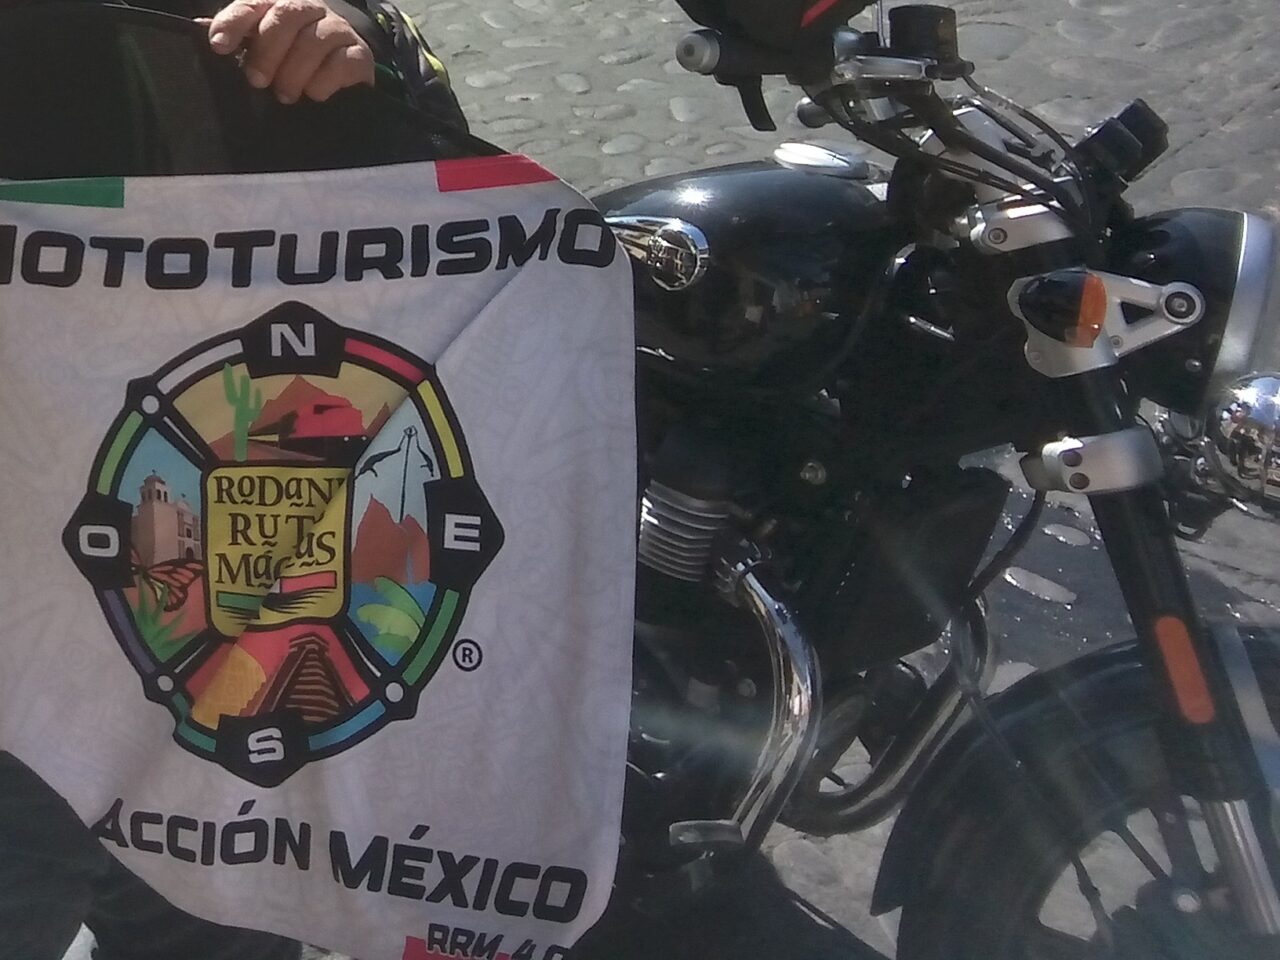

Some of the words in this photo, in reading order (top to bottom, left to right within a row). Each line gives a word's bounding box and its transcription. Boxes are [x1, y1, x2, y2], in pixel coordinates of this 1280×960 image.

[271, 323, 316, 357] N
[78, 525, 120, 557] O
[443, 513, 482, 552] E
[247, 727, 285, 763] S
[90, 797, 312, 871] ACCIÓN
[328, 824, 588, 924] MÉXICO
